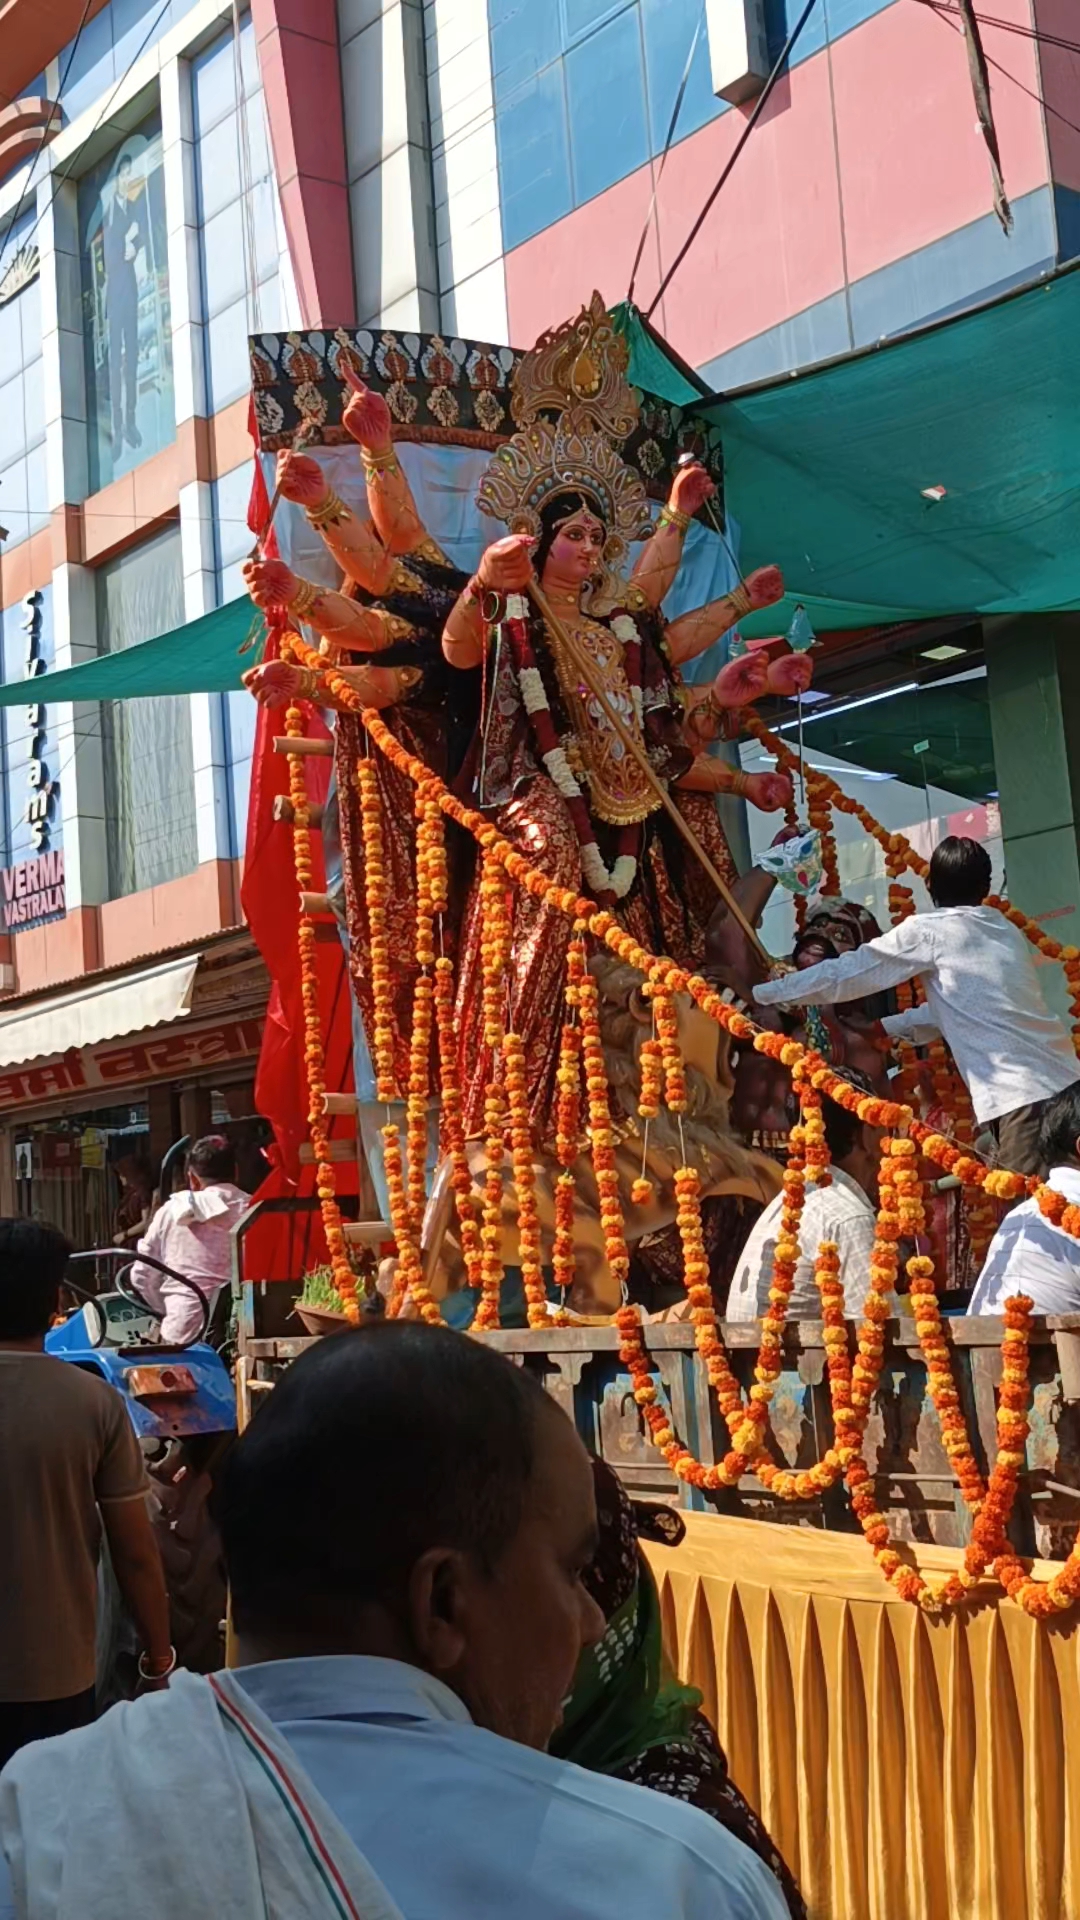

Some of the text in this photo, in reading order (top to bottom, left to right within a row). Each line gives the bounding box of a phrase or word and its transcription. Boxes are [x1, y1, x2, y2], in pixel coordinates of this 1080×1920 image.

[2, 849, 65, 902] VERMA
[3, 885, 66, 927] VASTRALA
[93, 1020, 262, 1081] वस्त्रा
